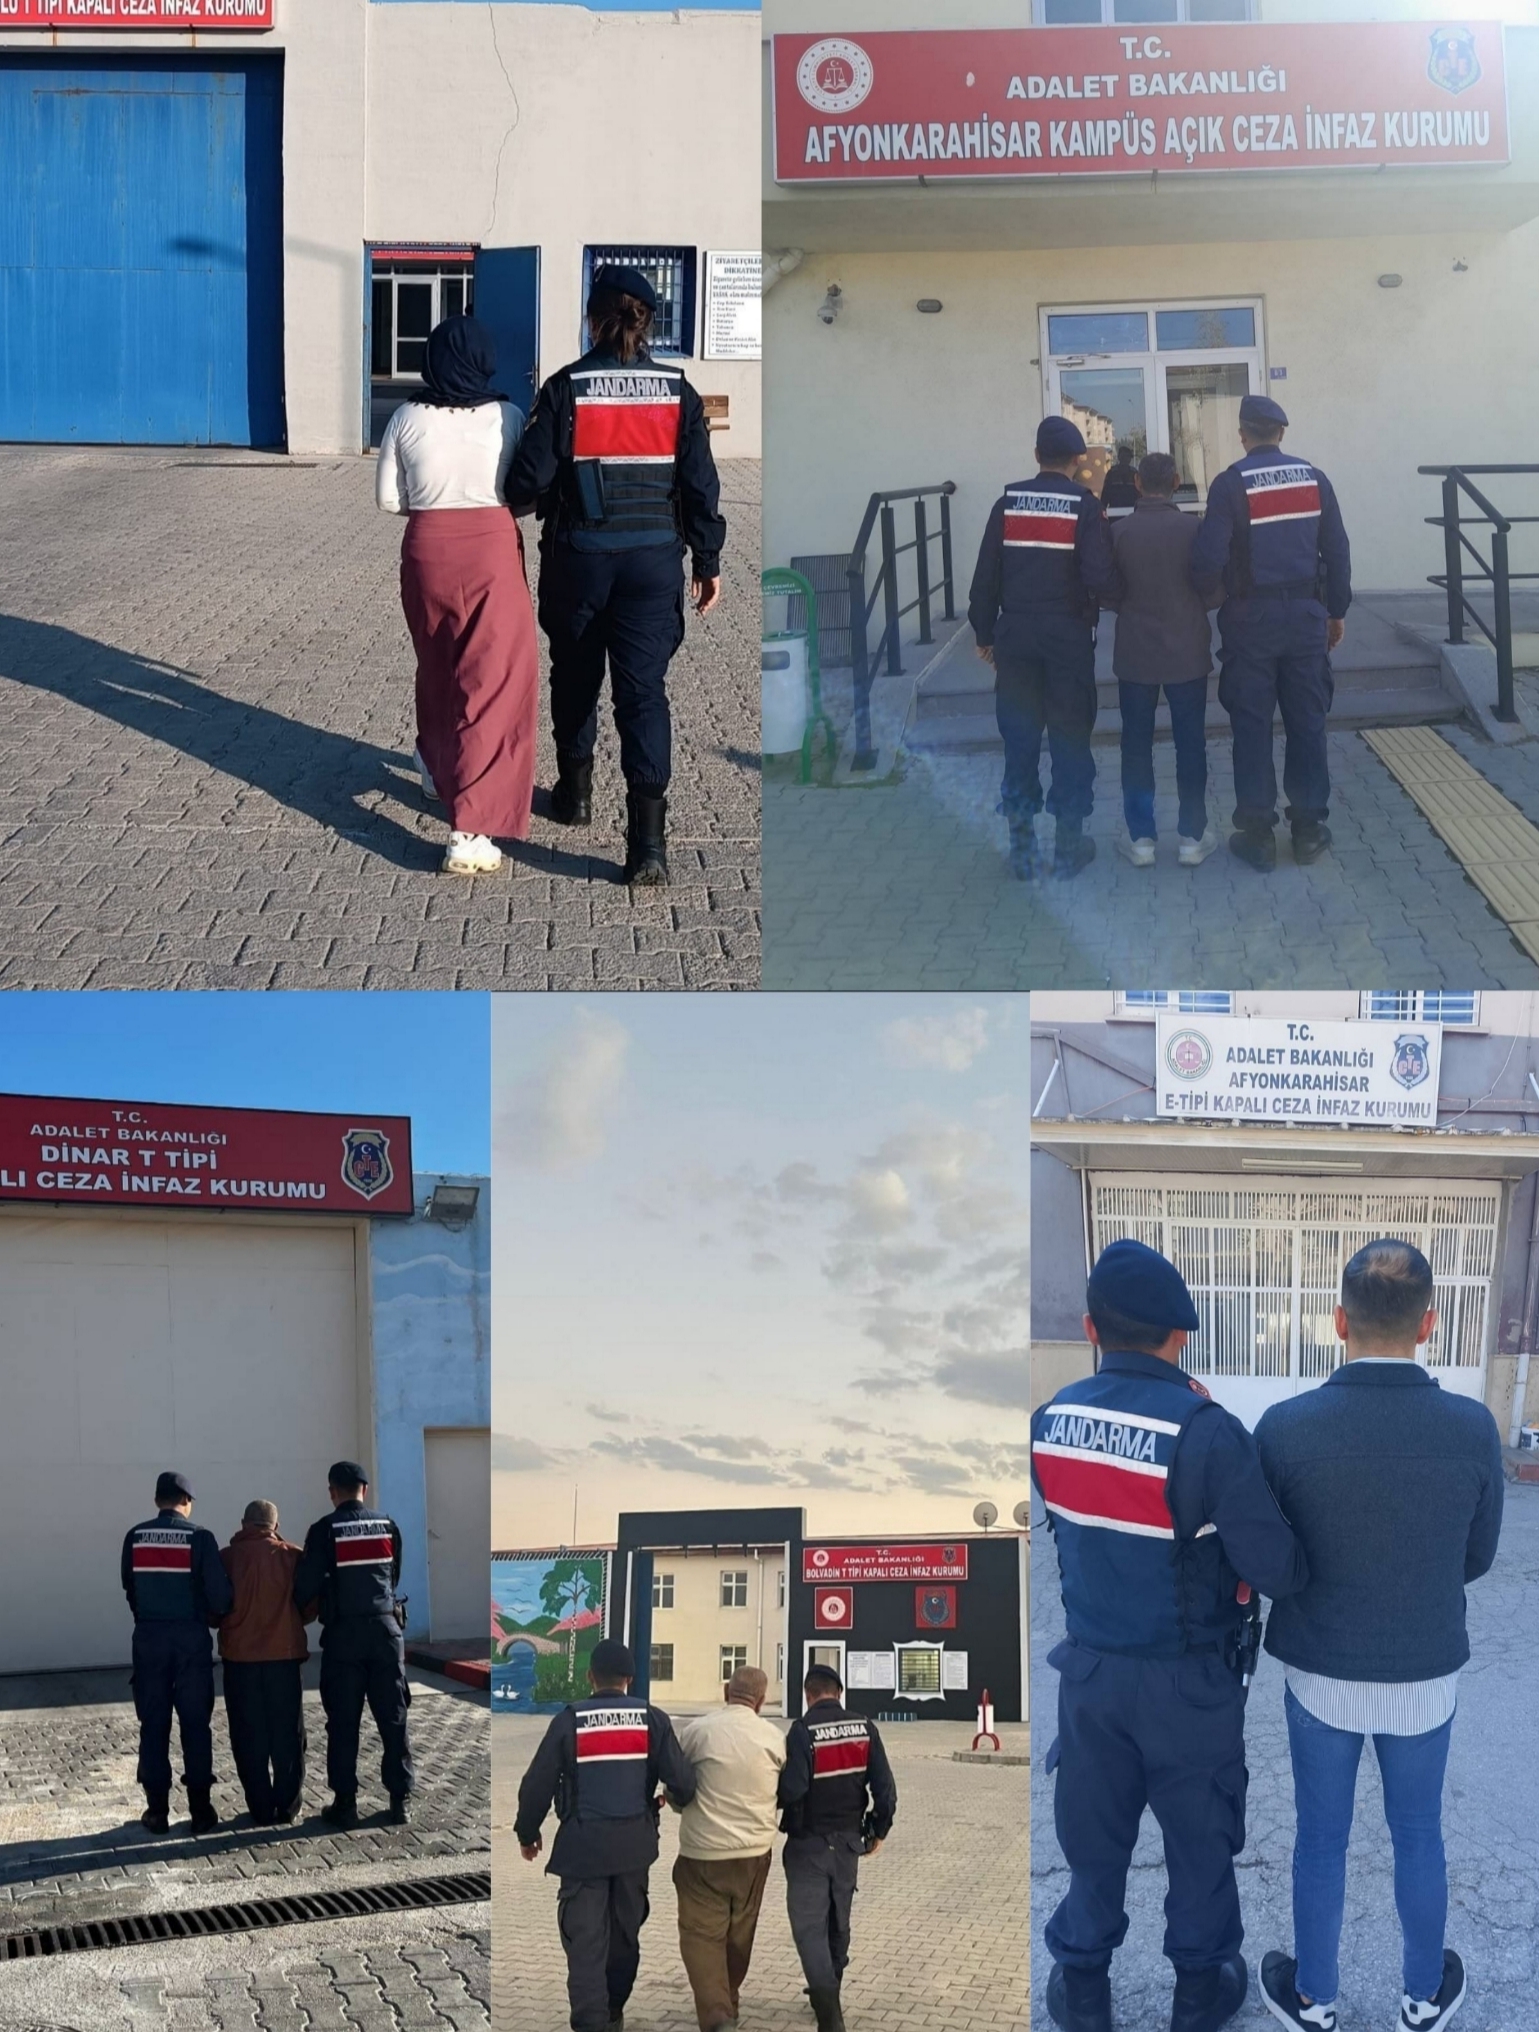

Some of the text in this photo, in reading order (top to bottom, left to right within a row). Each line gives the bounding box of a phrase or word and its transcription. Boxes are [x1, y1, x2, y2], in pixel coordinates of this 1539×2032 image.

[66, 0, 116, 15] KAPALI
[120, 0, 157, 15] CEZA
[205, 0, 266, 16] KURUMU
[1119, 35, 1171, 60] T.C.
[1006, 64, 1286, 99] ADALET BAKANLIĞI
[804, 104, 1490, 163] AFYONKARAHİSAR KAMPÜS AÇIK CEZA İNFAZ KURUMU
[586, 377, 671, 397] JANDARMA
[1252, 468, 1312, 489] JANDARMA
[1012, 495, 1071, 514] JANDARMA
[1286, 1023, 1314, 1041] T.C.
[1226, 1046, 1374, 1068] ADALET BAKANLIĞI
[1228, 1071, 1370, 1093] AFYONKARAHİSAR
[1165, 1090, 1431, 1119] E-TİPİ KAPALI CEZA İNFAZ KURUMU
[111, 1110, 148, 1123] T.C.
[30, 1124, 227, 1145] ADALET BAKANLIĞI
[41, 1142, 217, 1170] DİNAR T TİPİ
[0, 1169, 326, 1199] LI CEZA İNFAZ KURUMU
[1044, 1414, 1157, 1463] JANDARMA
[138, 1532, 188, 1544] JANDARMA
[806, 1564, 964, 1578] BOLVADİN T TİPİ KAPALI CEZA İNFAZ KURUMU
[583, 1711, 644, 1727] JANDARMA
[814, 1723, 868, 1741] JANDARMA
